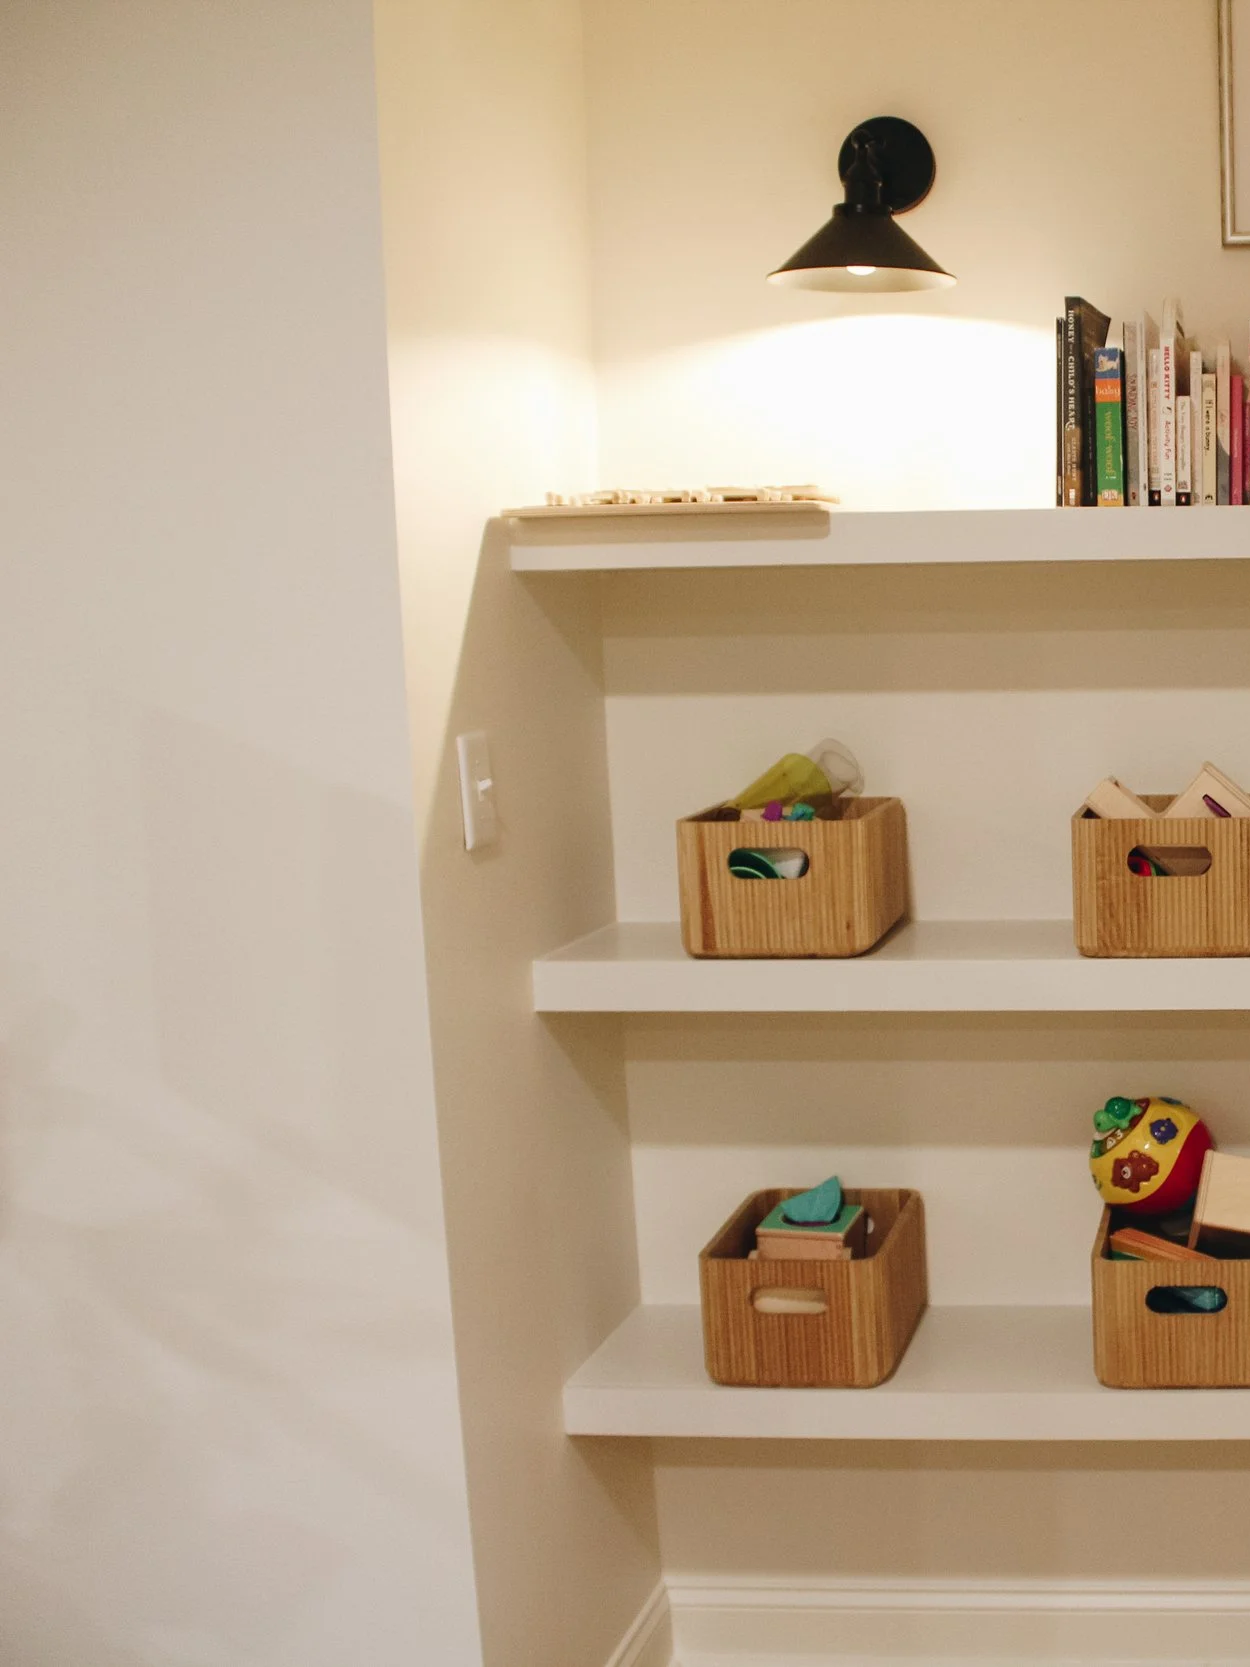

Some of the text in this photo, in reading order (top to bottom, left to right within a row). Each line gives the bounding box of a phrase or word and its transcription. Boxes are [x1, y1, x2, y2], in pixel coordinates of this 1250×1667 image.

[1068, 356, 1076, 396] CHILD'S
[1065, 397, 1076, 431] HEART
[1163, 420, 1172, 460] Activity Fun
